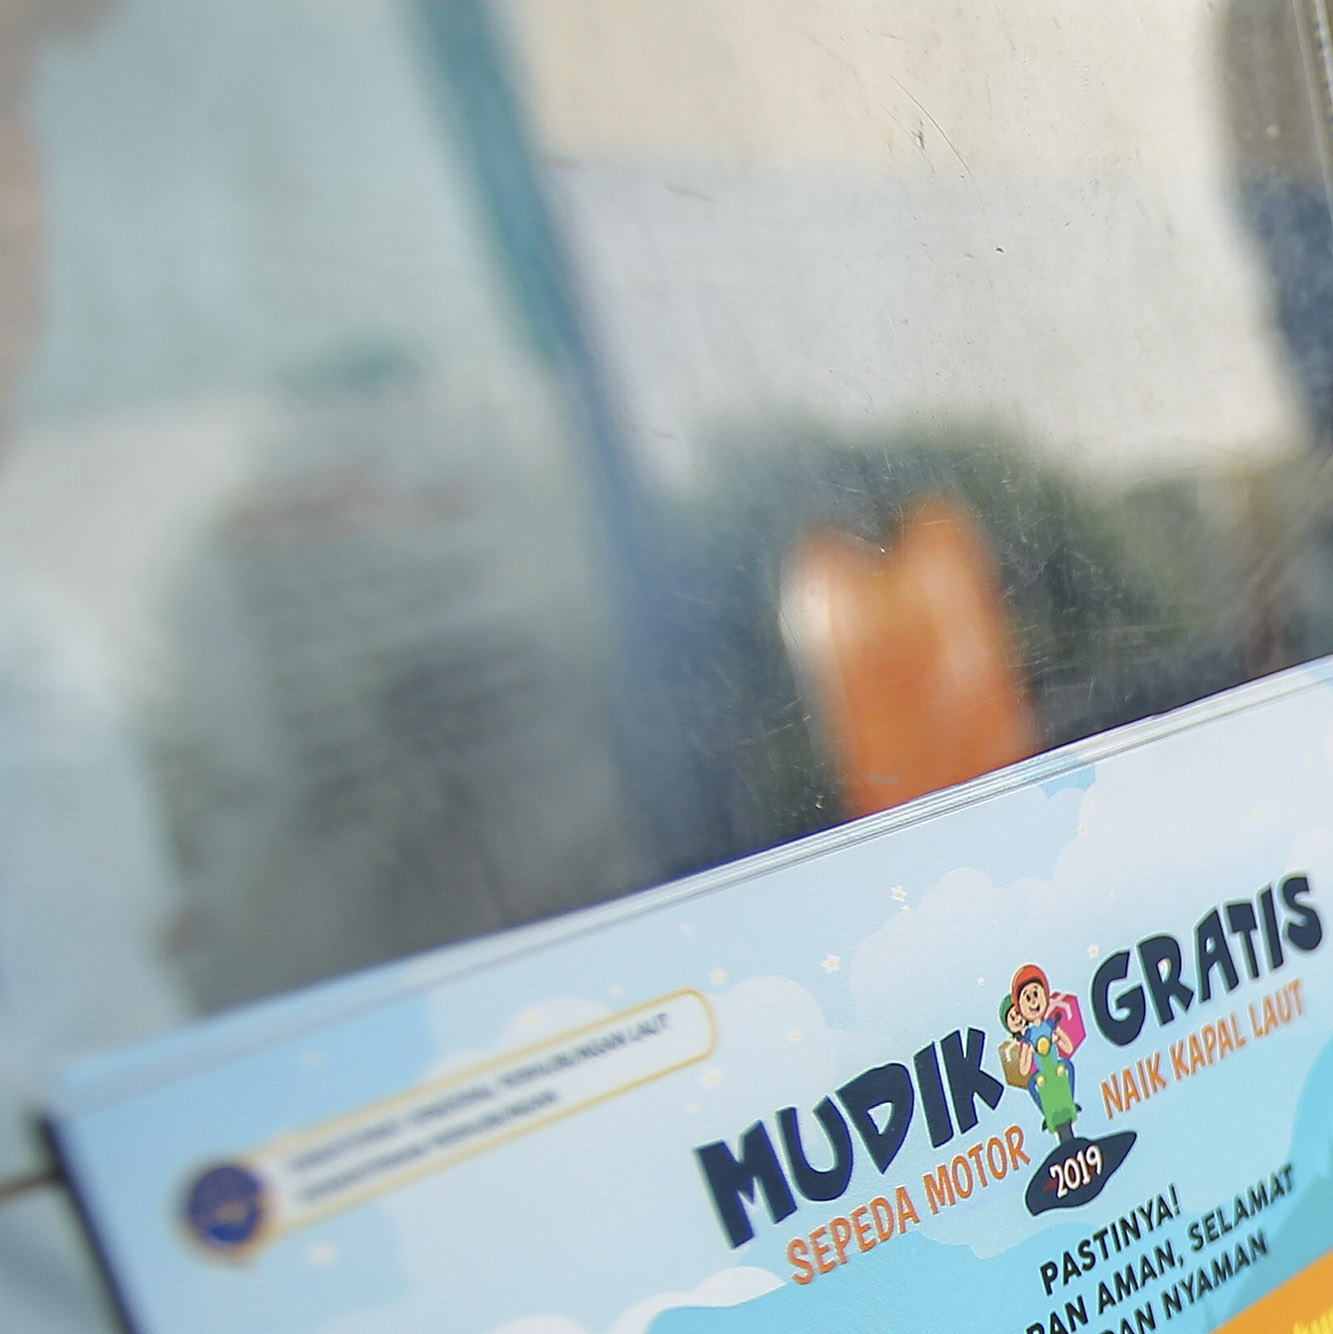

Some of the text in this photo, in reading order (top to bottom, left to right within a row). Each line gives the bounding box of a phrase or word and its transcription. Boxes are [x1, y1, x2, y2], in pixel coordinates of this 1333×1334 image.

[693, 1025, 1007, 1250] MUDIK
[1089, 872, 1326, 1048] GRATIS
[786, 978, 1302, 1286] SEPEDA MOTOR NAIK KAPAL LAUT
[1048, 1145, 1104, 1200] 2019
[1038, 1183, 1181, 1297] PASTINYA!
[1097, 1238, 1184, 1315] AMAN,
[1187, 1162, 1293, 1252] SELAMAT
[1160, 1229, 1268, 1320] NYAMAN
